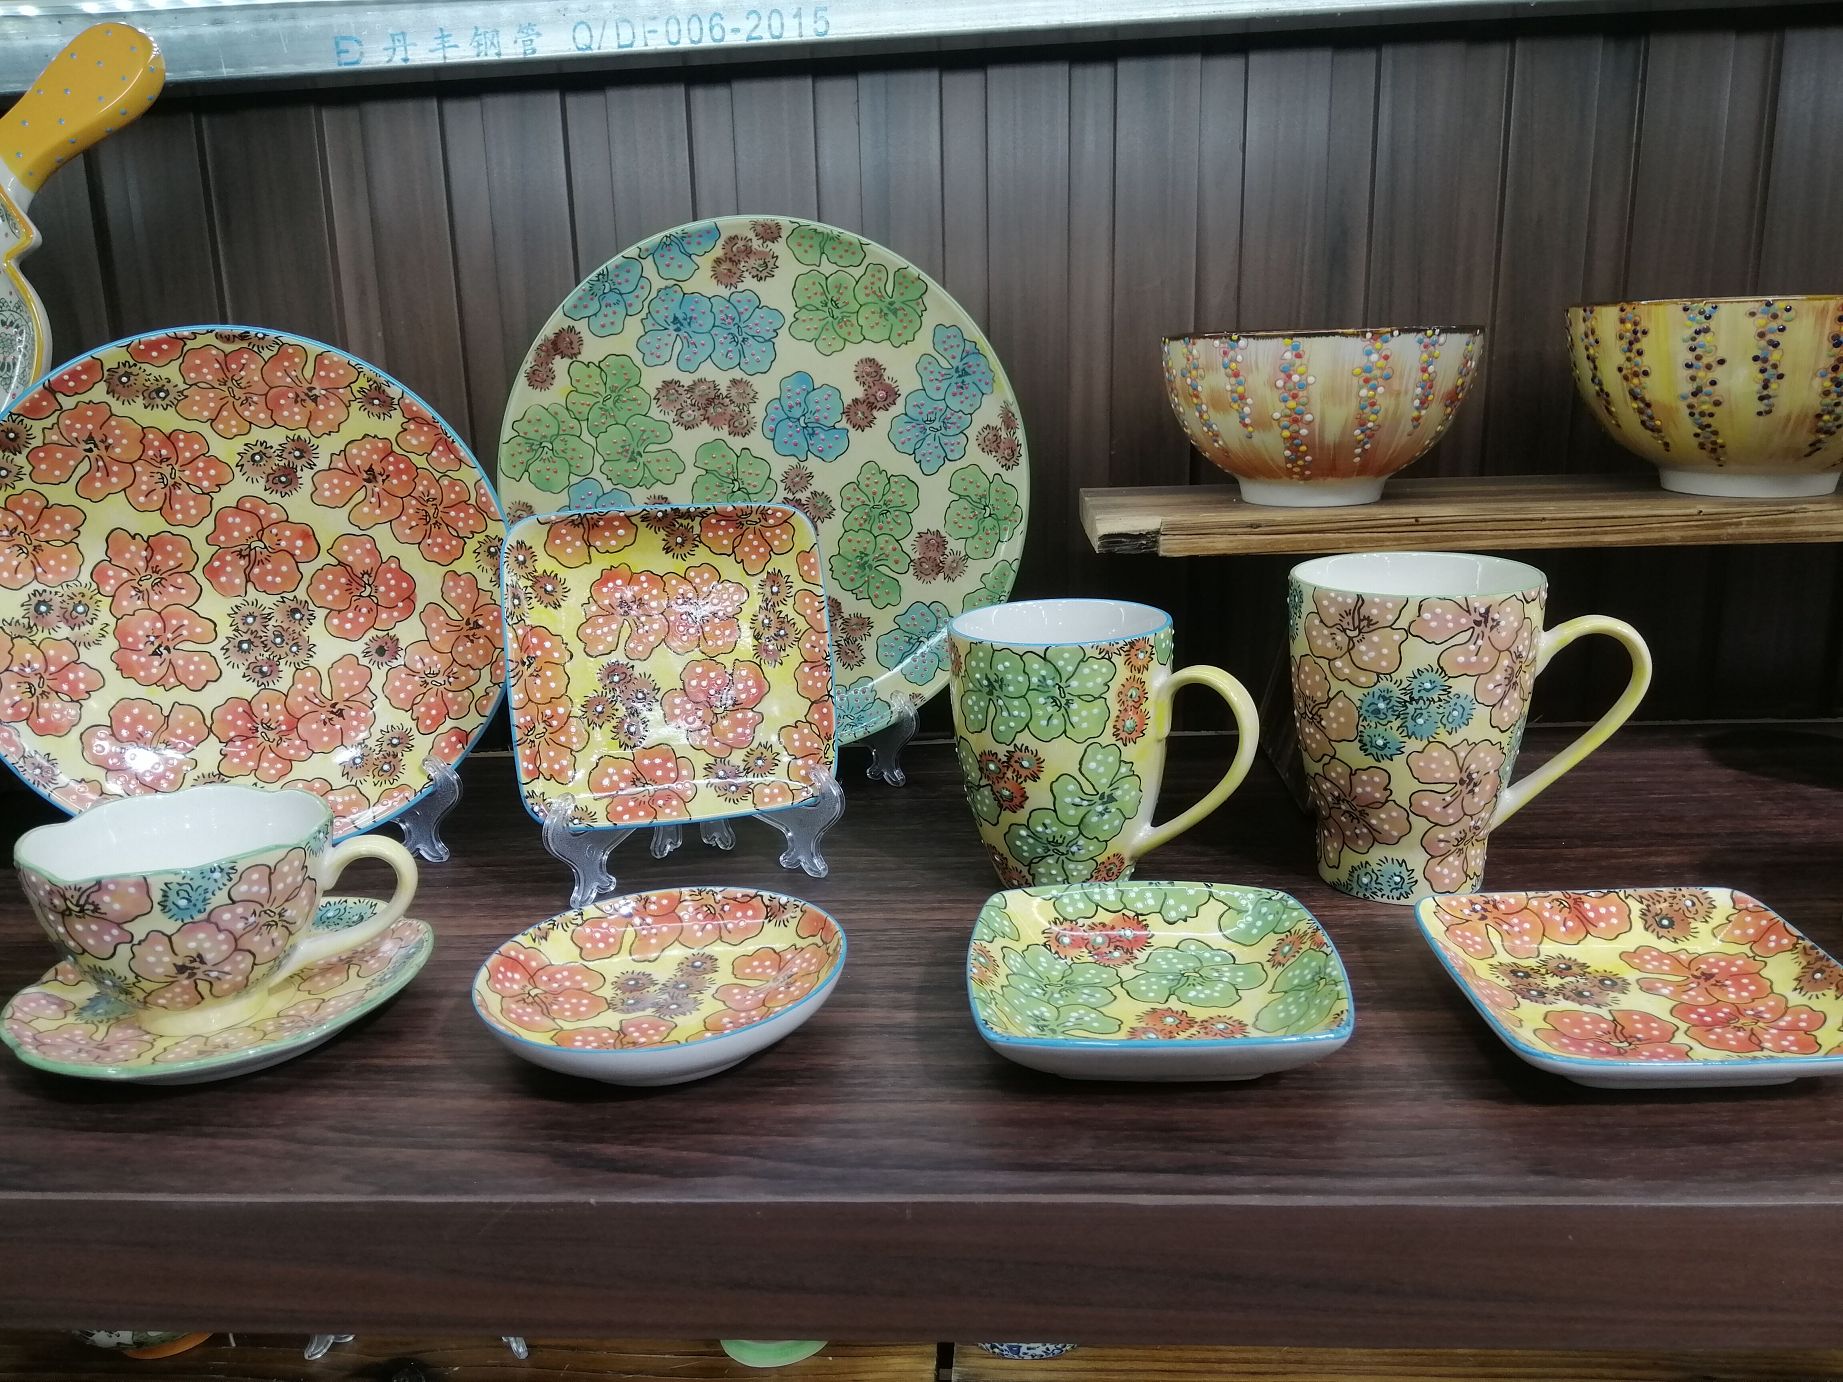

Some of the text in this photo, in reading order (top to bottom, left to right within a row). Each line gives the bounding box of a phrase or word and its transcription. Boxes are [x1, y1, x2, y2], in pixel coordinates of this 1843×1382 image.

[383, 22, 542, 64] 丹丰钢管
[572, 6, 830, 51] Q/DF006-2015
